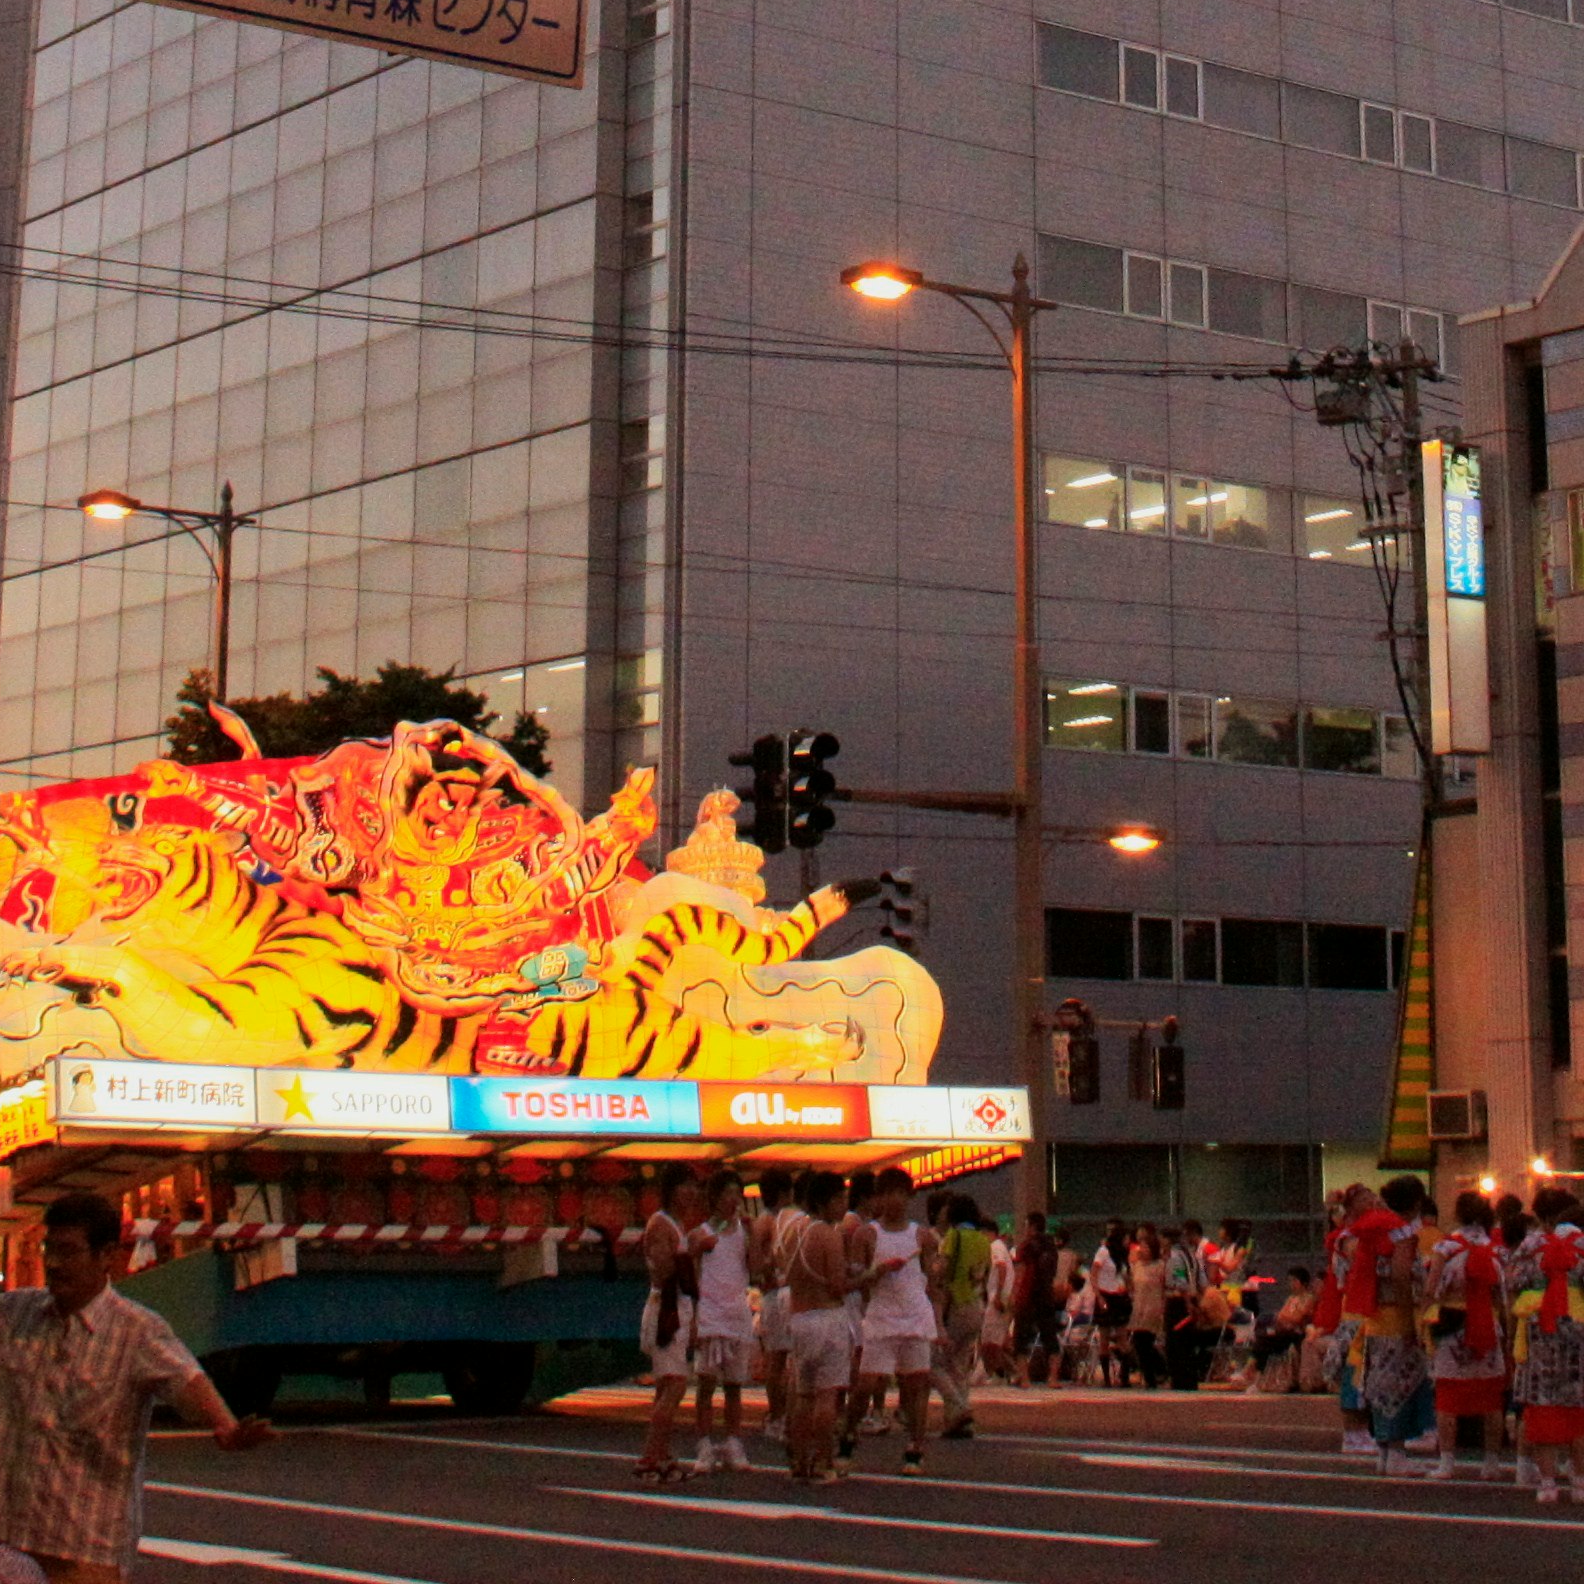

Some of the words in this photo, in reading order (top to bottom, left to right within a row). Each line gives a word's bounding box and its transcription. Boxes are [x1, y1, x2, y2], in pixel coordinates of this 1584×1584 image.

[107, 1077, 247, 1108] 村上新町病院
[331, 1091, 433, 1115] SAPPORO
[501, 1091, 650, 1121] TOSHIBA
[730, 1092, 785, 1126] au
